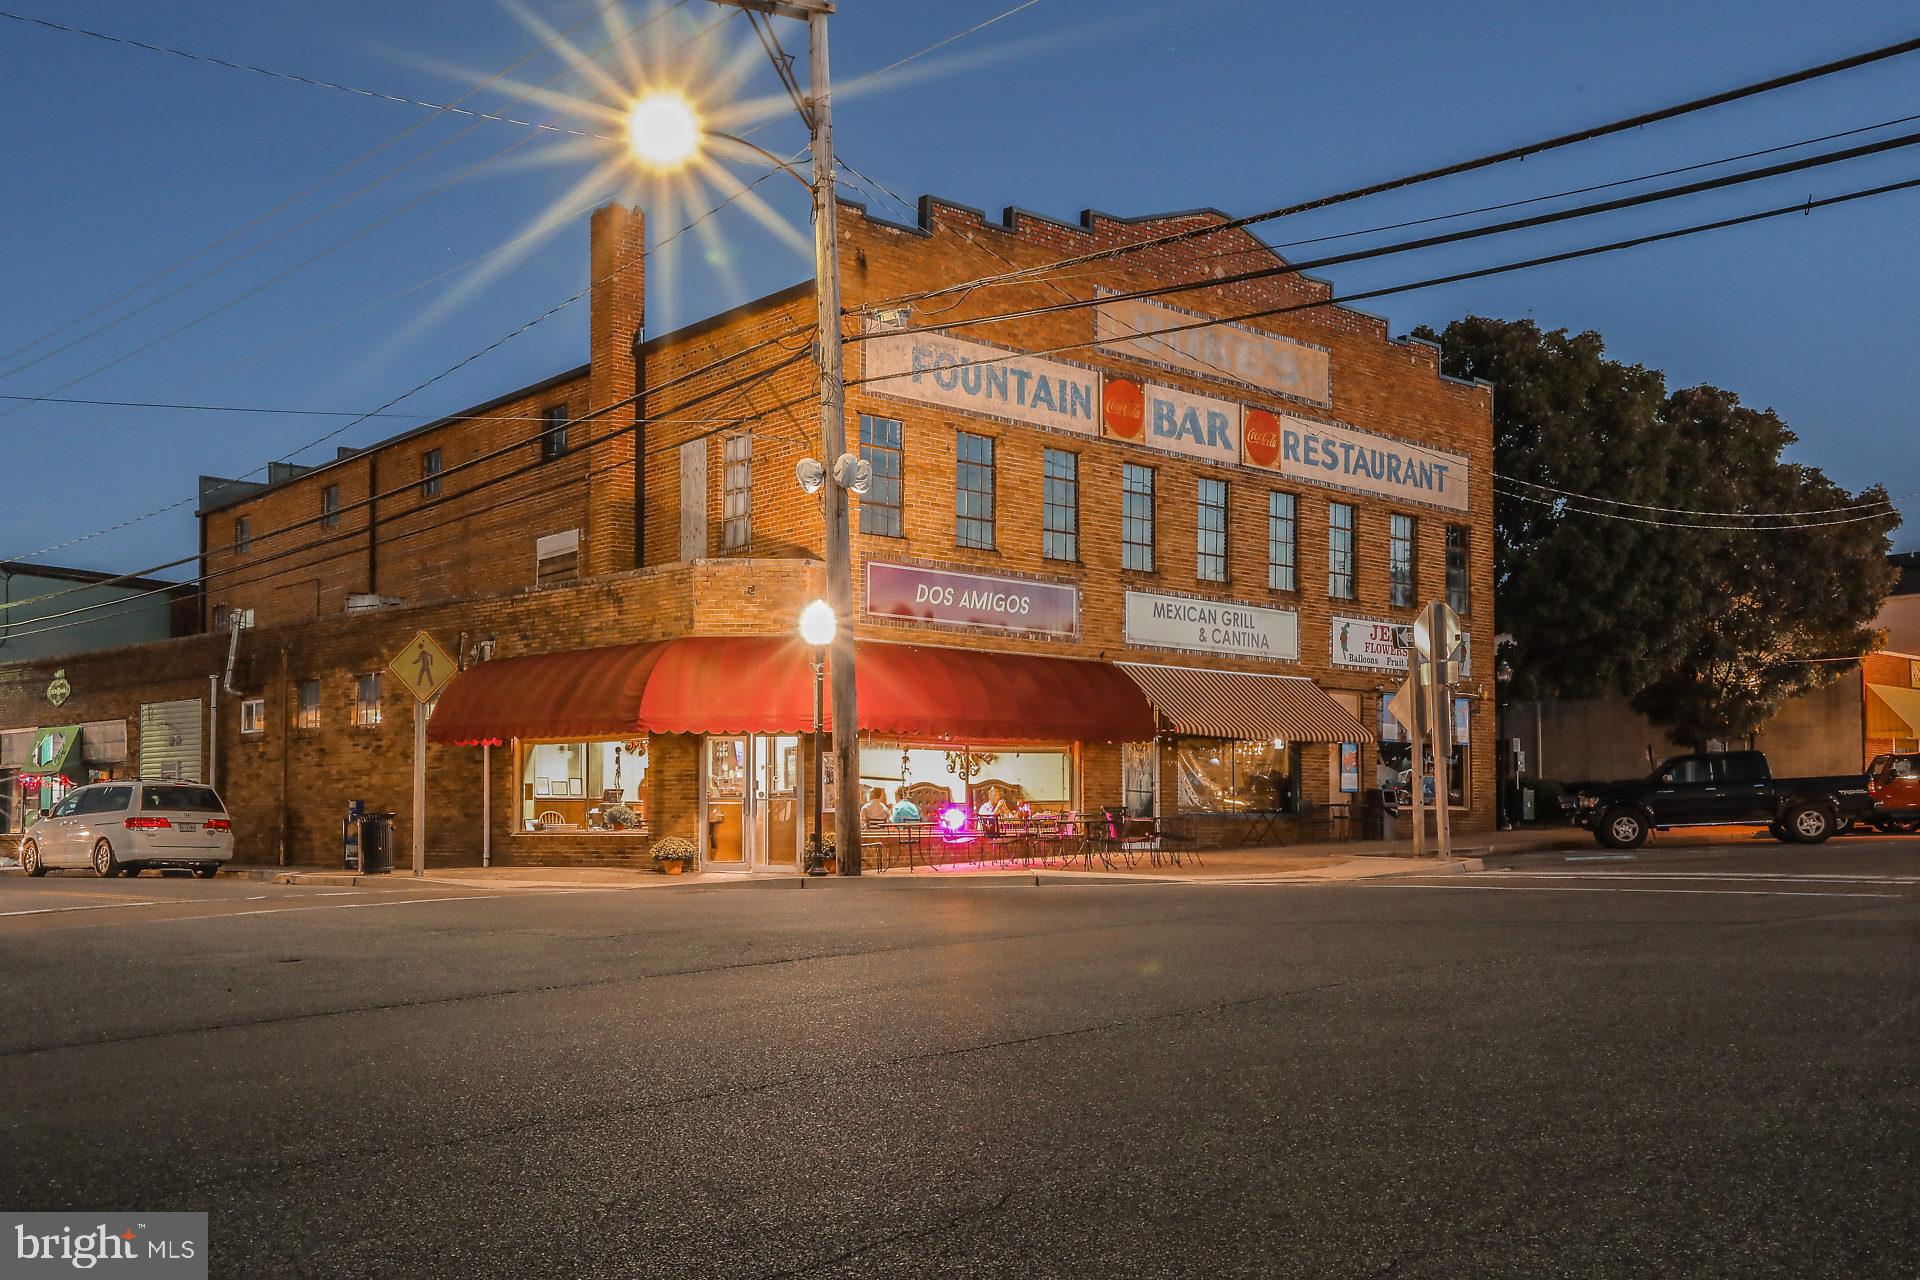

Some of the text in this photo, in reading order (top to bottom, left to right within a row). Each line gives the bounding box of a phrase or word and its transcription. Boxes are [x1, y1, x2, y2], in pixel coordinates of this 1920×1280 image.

[911, 343, 1449, 493] FOUNTAIN BAR RESTAURANT
[916, 583, 1030, 615] DOS AMIGOS
[1152, 602, 1256, 630] MEXICAN GRILL
[1198, 627, 1270, 650] & CANTINA
[1348, 653, 1379, 665] Balloons
[1386, 656, 1404, 667] Fruit
